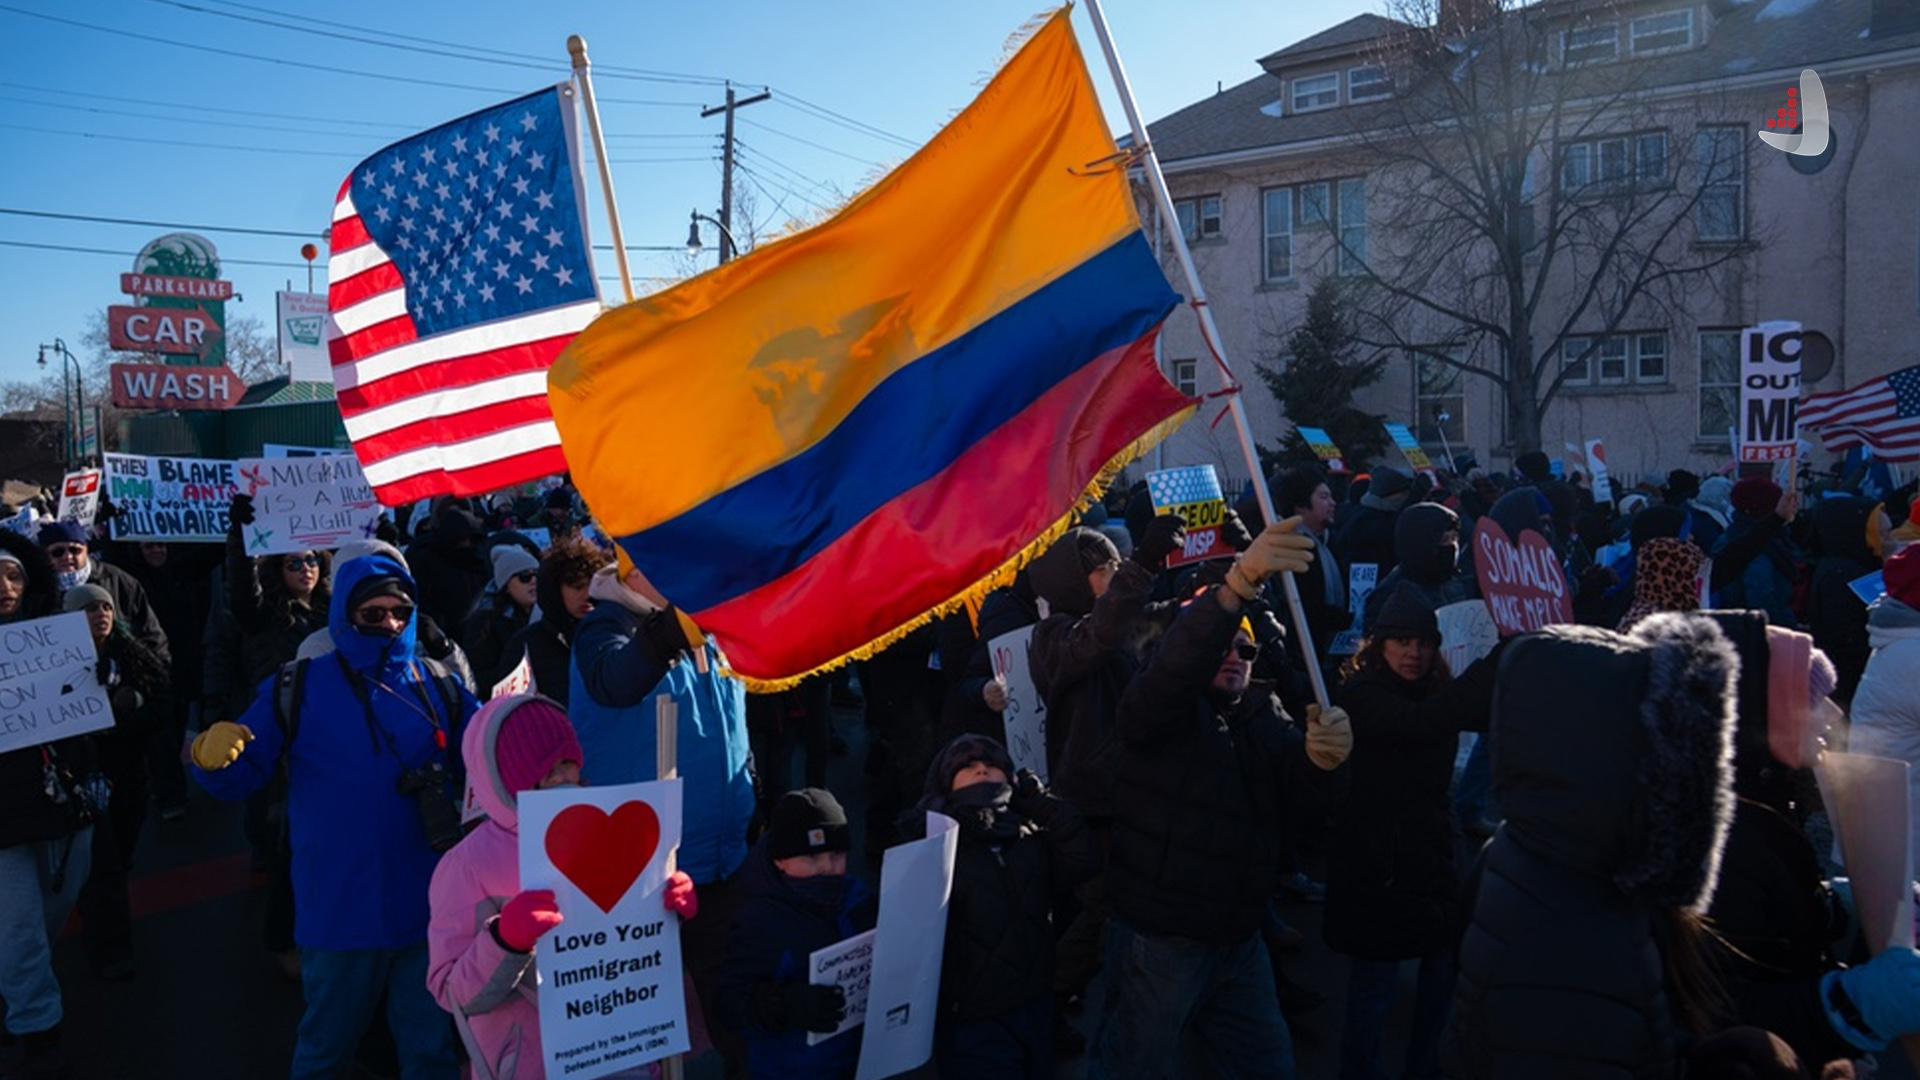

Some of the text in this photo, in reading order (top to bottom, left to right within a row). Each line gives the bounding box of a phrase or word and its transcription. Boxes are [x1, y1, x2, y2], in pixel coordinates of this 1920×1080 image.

[131, 276, 174, 293] PARK
[188, 281, 226, 297] LAKE
[124, 314, 205, 344] CAR
[122, 370, 230, 400] WASH
[106, 457, 235, 485] THEY BLAME
[264, 494, 297, 515] IS
[314, 489, 331, 507] A
[289, 508, 354, 534] RIGHT
[1183, 530, 1215, 558] MSP
[1480, 531, 1564, 598] SOMALIS
[4, 625, 59, 654] ONE
[0, 647, 93, 680] ILLEGAL
[0, 682, 36, 710] ON
[46, 696, 103, 725] LAND
[554, 921, 664, 953] Love Your
[554, 949, 662, 988] Immigrant
[566, 984, 659, 1020] Neighbor
[554, 1020, 676, 1061] Prepared by the Immigrant
[564, 1036, 669, 1074] Defense Network (IDN)
